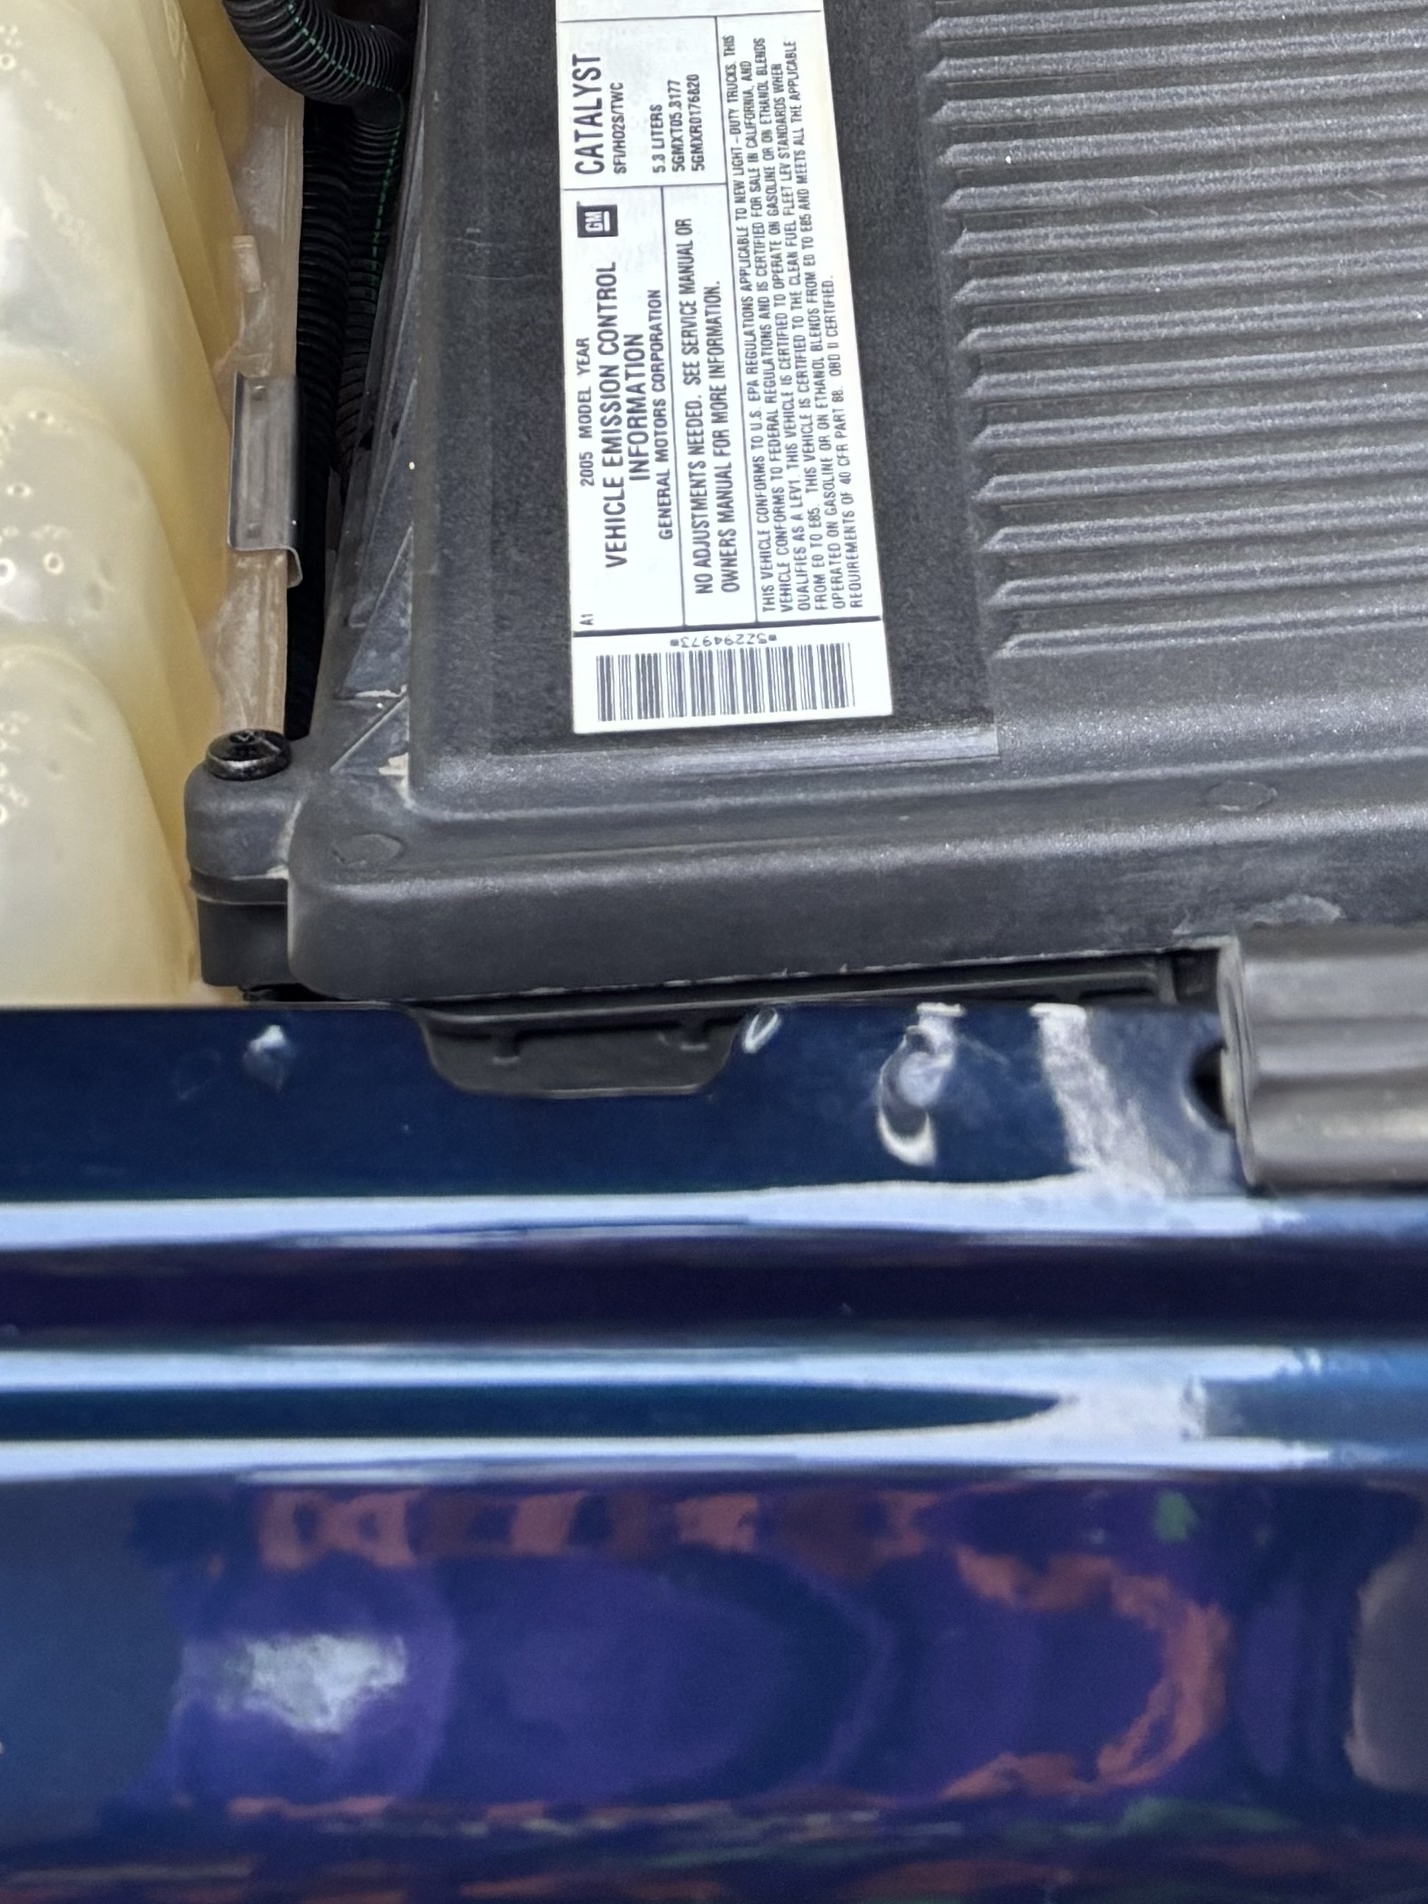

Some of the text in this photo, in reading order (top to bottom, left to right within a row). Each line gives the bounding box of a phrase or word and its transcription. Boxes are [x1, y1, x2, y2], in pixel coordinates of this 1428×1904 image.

[739, 60, 752, 81] AND
[752, 37, 768, 75] BLENDS
[783, 41, 801, 101] APPLICABLE
[770, 63, 785, 93] WHEN
[571, 52, 605, 175] CATALYST
[756, 80, 772, 124] ETHANOL
[789, 104, 803, 122] THE
[649, 103, 666, 173] 5.3 LITERS
[760, 129, 773, 143] ON
[772, 96, 791, 158] STANDARDS
[791, 127, 805, 145] ALL
[761, 147, 774, 160] OR
[793, 149, 808, 184] MEETS
[747, 167, 761, 192] SALE
[778, 162, 792, 181] LEV
[763, 165, 779, 216] GASOLINE
[780, 185, 795, 215] FLEET
[796, 188, 811, 210] AND
[584, 210, 601, 232] GM
[749, 196, 763, 217] FOR
[767, 221, 780, 235] ON
[783, 219, 798, 246] FUEL
[798, 213, 812, 232] E85
[751, 221, 768, 276] CERTIFIED
[800, 235, 814, 249] TO
[768, 240, 785, 289] OPERATE
[786, 251, 801, 285] CLEAN
[756, 280, 768, 291] IS
[773, 293, 786, 307] TO
[788, 290, 803, 310] THE
[803, 271, 819, 303] FROM
[757, 296, 771, 319] AND
[820, 276, 838, 337] CERTIFIED.
[722, 34, 776, 612] THIS VEHICLE CONFORMS TO EPA REGULATIONS APPLICABLE TO NEW THIS
[791, 315, 804, 329] TO
[806, 307, 823, 351] BLENDS
[774, 312, 792, 369] CERTIFIED
[758, 324, 777, 403] REGULATIONS
[792, 334, 810, 392] CERTIFIED
[827, 353, 842, 376] OBD
[779, 374, 792, 385] IS
[810, 356, 828, 408] ETHANOL
[575, 337, 594, 486] 2005 MODEL YEAR
[594, 261, 627, 567] VEHICLE EMISSION CONTROL
[622, 333, 650, 480] INFORMATION
[646, 288, 673, 539] GENERAL MOTORS CORPORATION
[674, 218, 713, 594] NO ADJUSTMENTS NEEDED. SEE SERVICE MANUAL OR
[780, 391, 797, 437] VEHICLE
[798, 397, 811, 408] IS
[765, 408, 782, 461] FEDERAL
[816, 413, 830, 429] ON
[831, 407, 847, 438] PART
[702, 281, 740, 592] OWNERS MANUAL FOR MORE INFORMATION.
[799, 414, 816, 461] VEHICLE
[817, 434, 831, 451] OR
[784, 442, 799, 469] THIS
[835, 443, 850, 466] CFR
[769, 466, 783, 480] TO
[803, 466, 818, 493] THIS
[819, 457, 838, 515] GASOLINE
[838, 471, 851, 484] 40
[840, 491, 854, 504] OF
[770, 486, 789, 555] CONFORMS
[806, 504, 821, 528] E85.
[825, 521, 839, 537] ON
[791, 525, 805, 541] AS
[809, 533, 823, 547] TO
[841, 510, 863, 608] REQUIREMENTS
[776, 562, 794, 612] VEHICLE
[792, 546, 811, 611] QUALIFIES
[827, 542, 846, 609] OPERATED
[812, 573, 828, 610] FROM
[579, 613, 593, 625] A1
